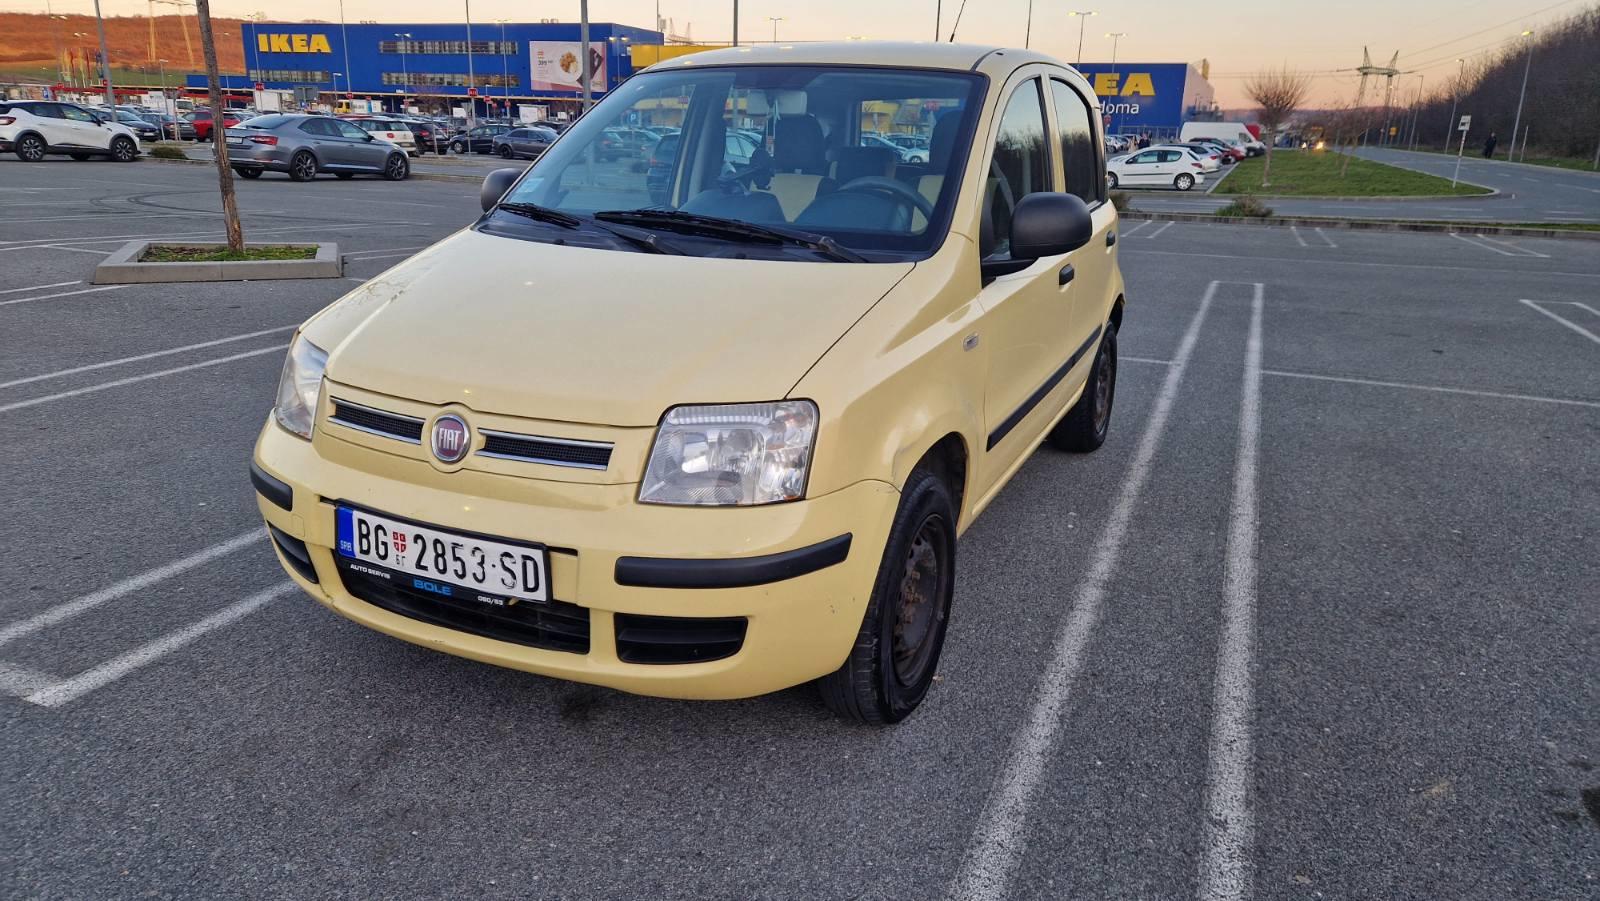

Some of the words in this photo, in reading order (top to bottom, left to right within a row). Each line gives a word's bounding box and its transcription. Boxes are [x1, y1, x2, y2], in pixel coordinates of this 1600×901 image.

[257, 34, 332, 53] IKEA
[1081, 73, 1156, 96] EA
[438, 428, 462, 450] FIAT
[340, 540, 352, 552] SRB
[357, 518, 389, 560] BG
[350, 563, 368, 573] AUTO
[368, 568, 391, 579] SERVIS
[413, 579, 452, 596] BOLE
